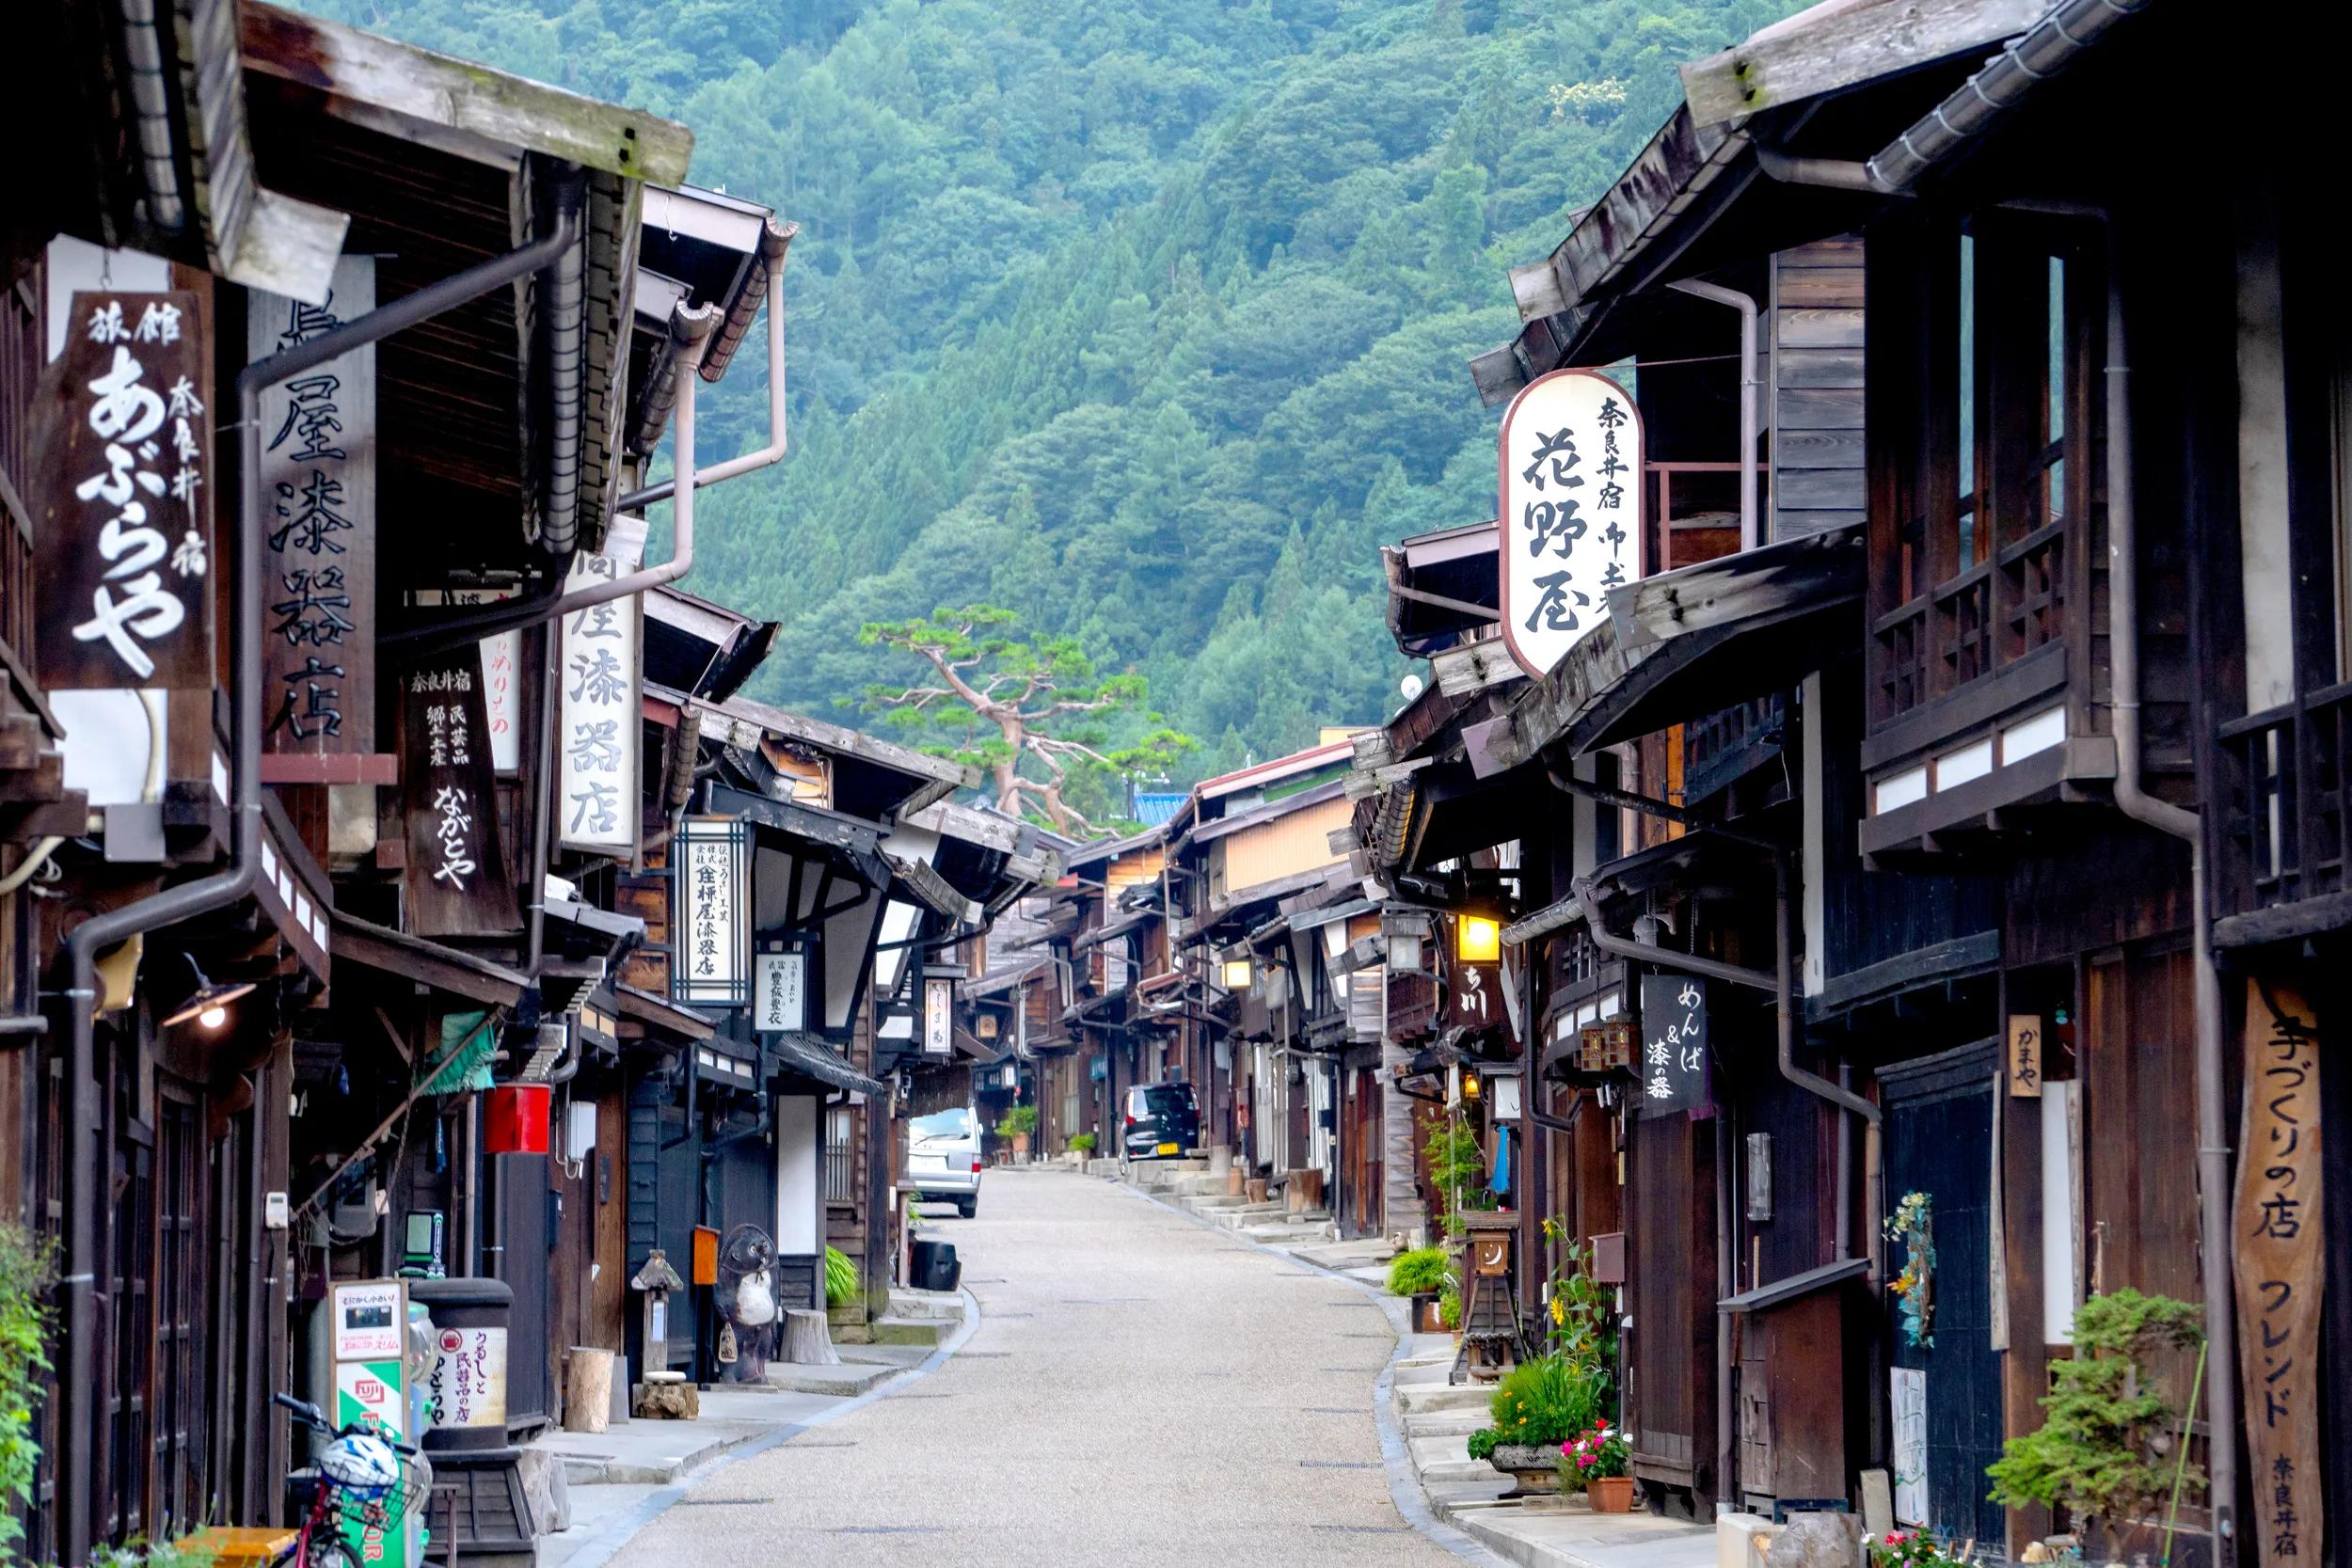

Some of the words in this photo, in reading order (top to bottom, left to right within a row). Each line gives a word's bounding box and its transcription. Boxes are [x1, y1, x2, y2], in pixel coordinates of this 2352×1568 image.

[87, 299, 183, 345] 旅館
[167, 374, 207, 578] 奈良井宿
[1596, 396, 1629, 510] 奈良井宿
[72, 344, 185, 679] あぶらや
[1522, 426, 1591, 634] 花野屋
[410, 667, 471, 693] 奈良井宿
[433, 783, 476, 892] ながとや
[1645, 1037, 1675, 1099] 漆の器
[1666, 1024, 1681, 1045] &
[1677, 981, 1704, 1073] めんぱ
[2251, 1016, 2312, 1239] 手づくりの店
[2272, 1451, 2298, 1559] 奈良井宿
